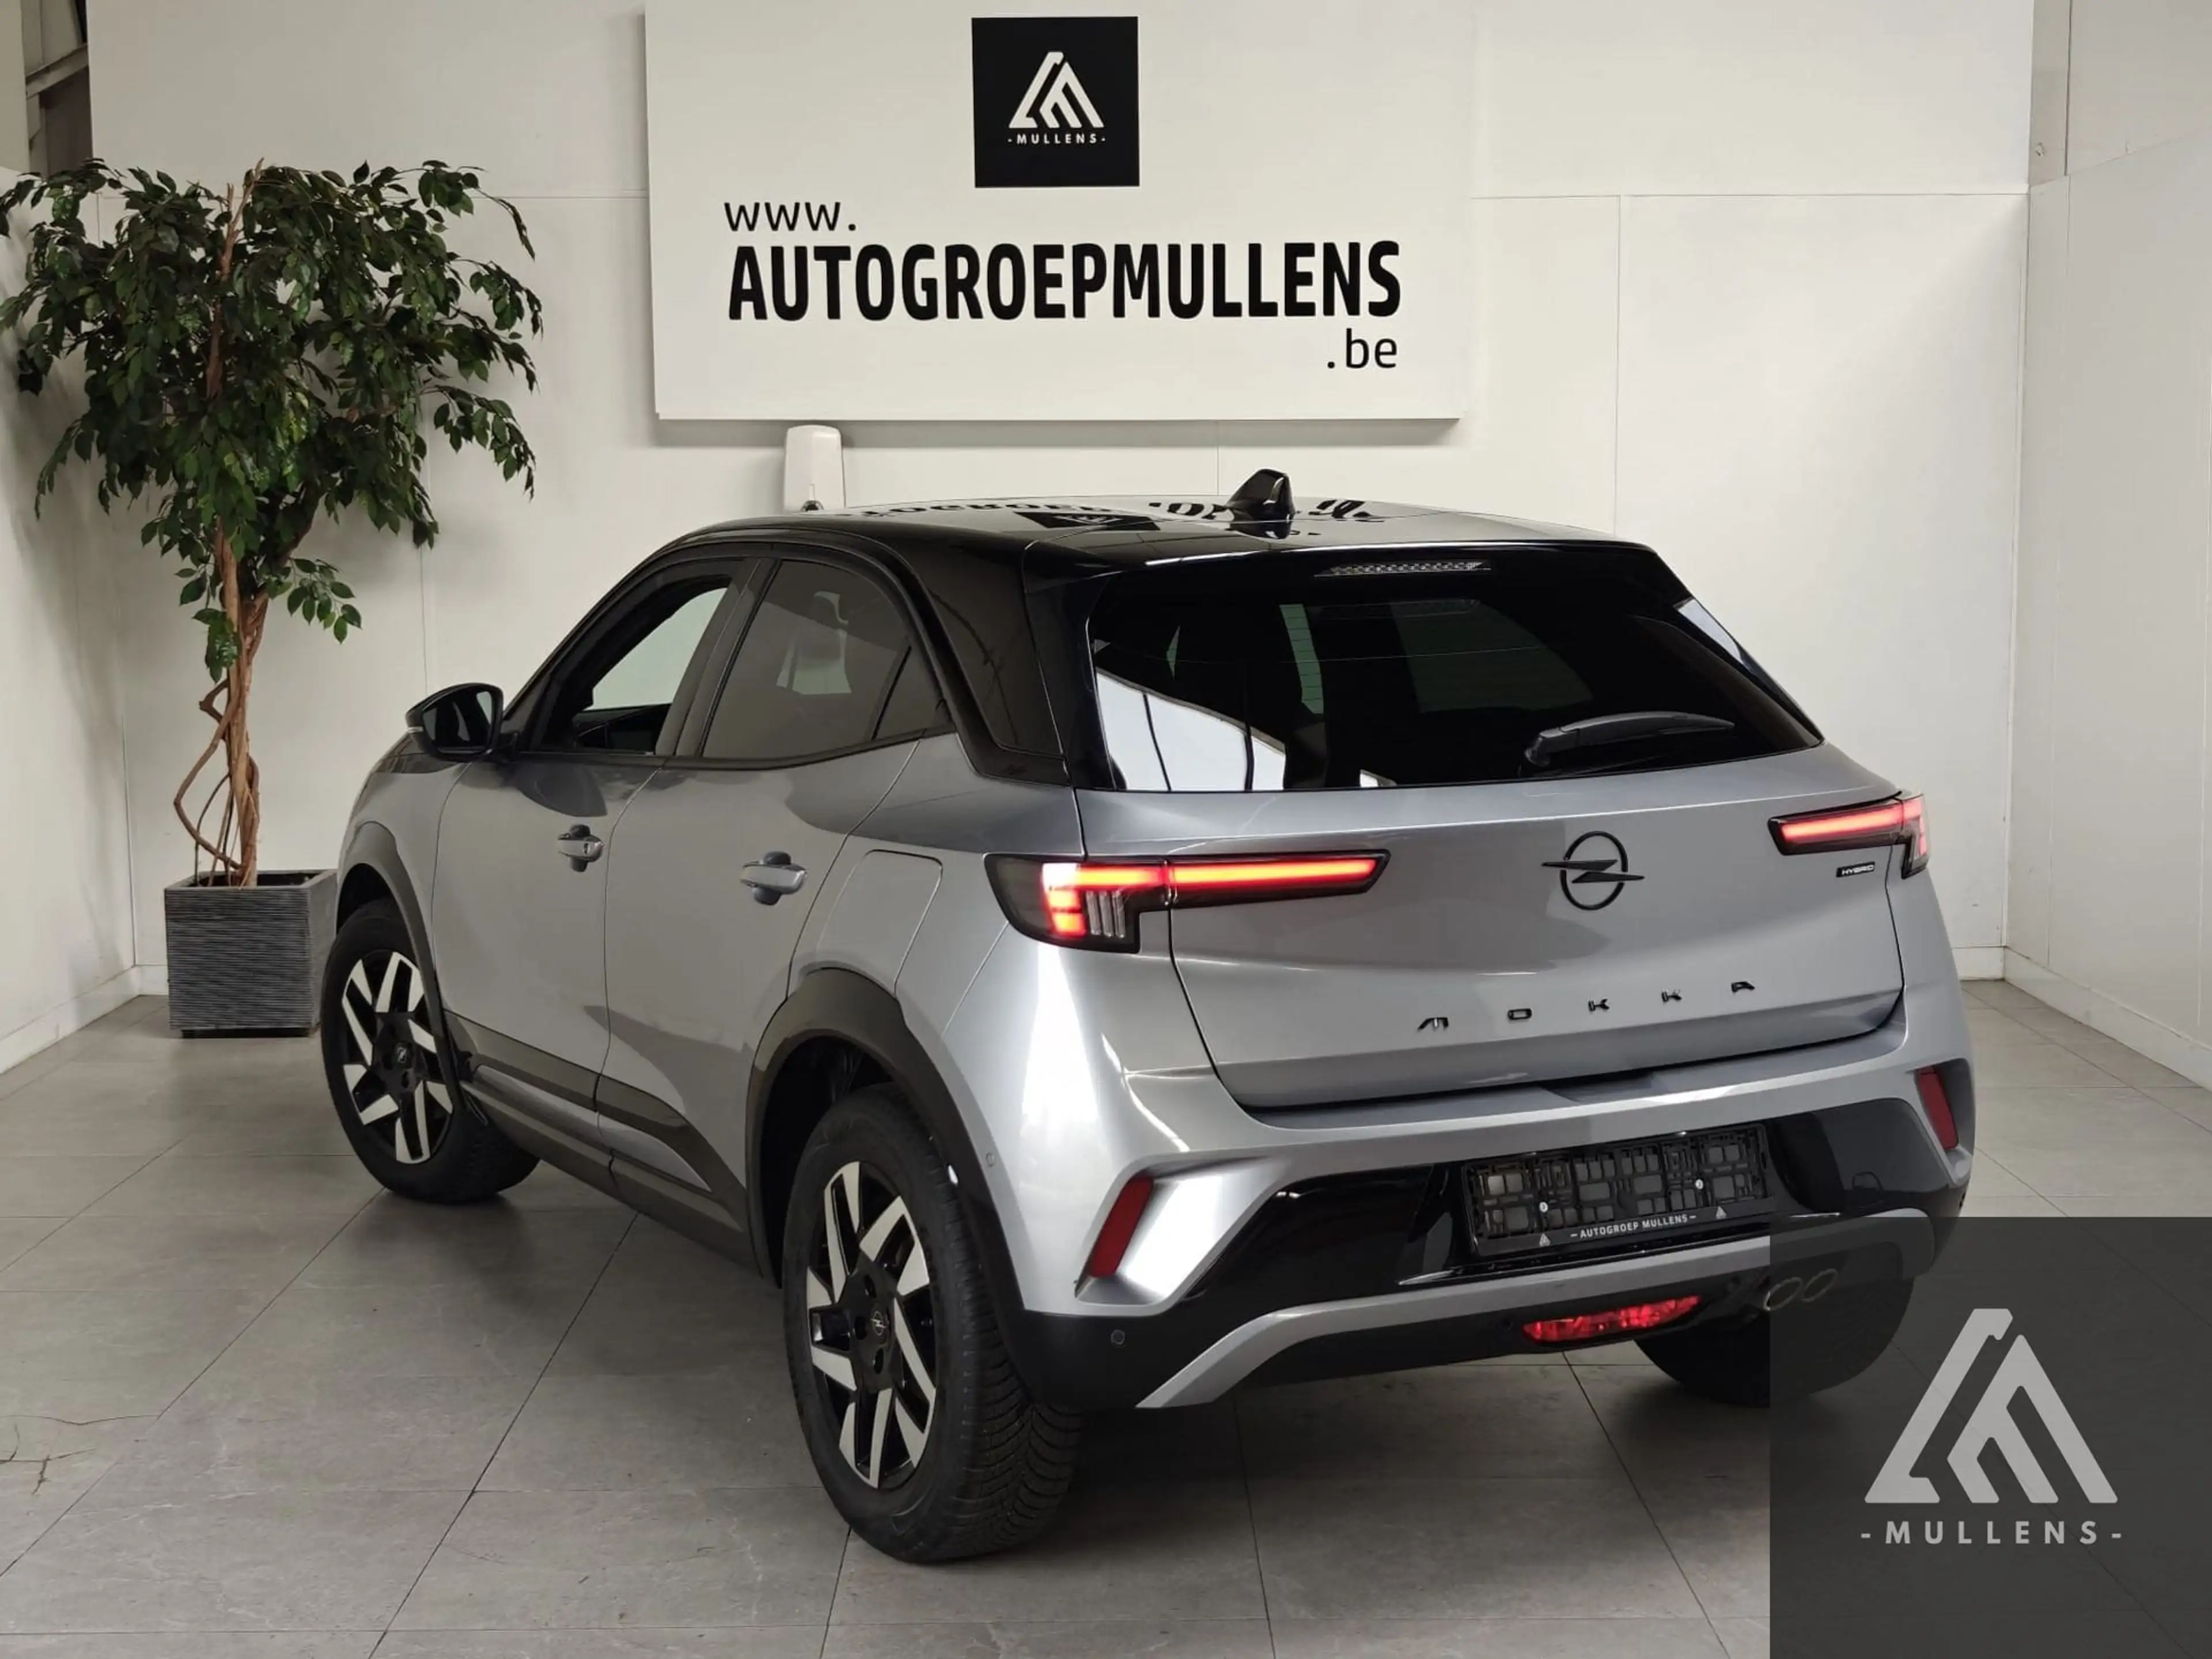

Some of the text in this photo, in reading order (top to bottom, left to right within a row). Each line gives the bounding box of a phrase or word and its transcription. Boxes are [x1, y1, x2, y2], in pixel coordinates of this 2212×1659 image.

[724, 201, 857, 232] www.
[728, 240, 1401, 322] AUTOGROEPMULLENS
[1327, 327, 1397, 369] .be
[1841, 864, 1874, 876] HYBRID
[1417, 980, 1755, 1031] MOKKA
